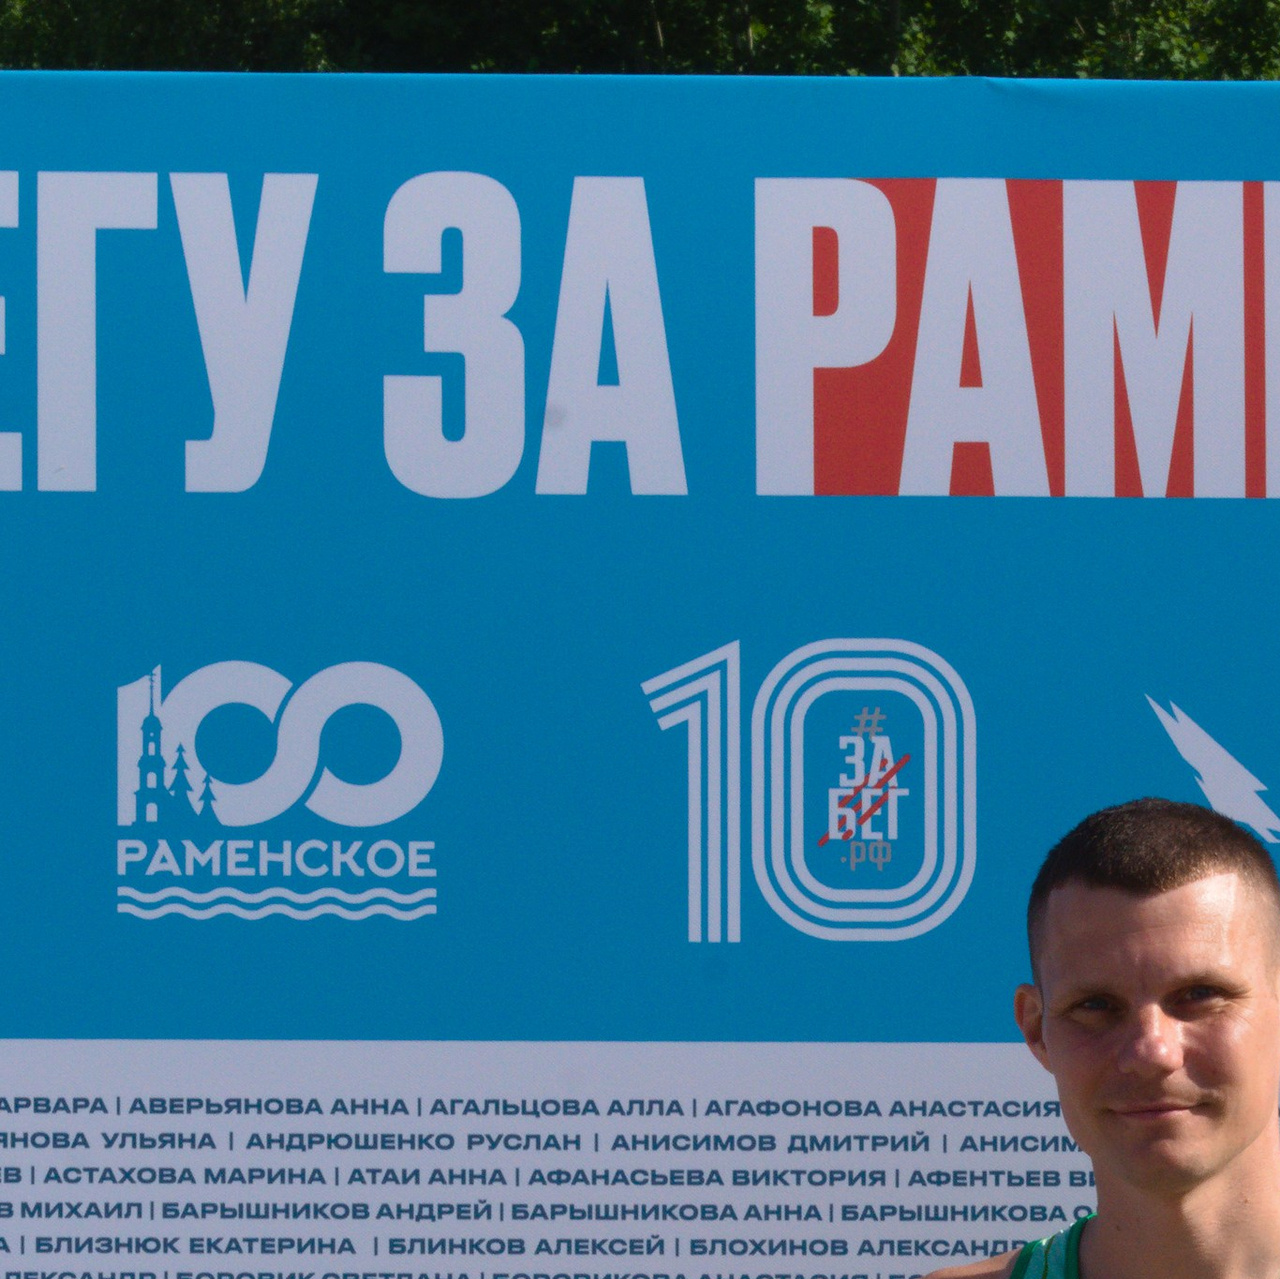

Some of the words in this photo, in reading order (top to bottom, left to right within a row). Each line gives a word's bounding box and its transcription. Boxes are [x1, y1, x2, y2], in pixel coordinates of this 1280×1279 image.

[0, 171, 318, 492] ГУ
[384, 171, 687, 498] ЗА
[642, 639, 976, 942] 10
[117, 839, 437, 877] РАМЕНСКОЕ
[129, 1098, 323, 1114] АВЕРЬЯНОВА
[331, 1099, 409, 1115] АННА
[44, 1167, 196, 1184] АСТАХОВА
[205, 1168, 326, 1184] МАРИНА
[36, 1237, 180, 1253] БЛИЗНЮК
[190, 1238, 356, 1254] ЕКАТЕРИНА
